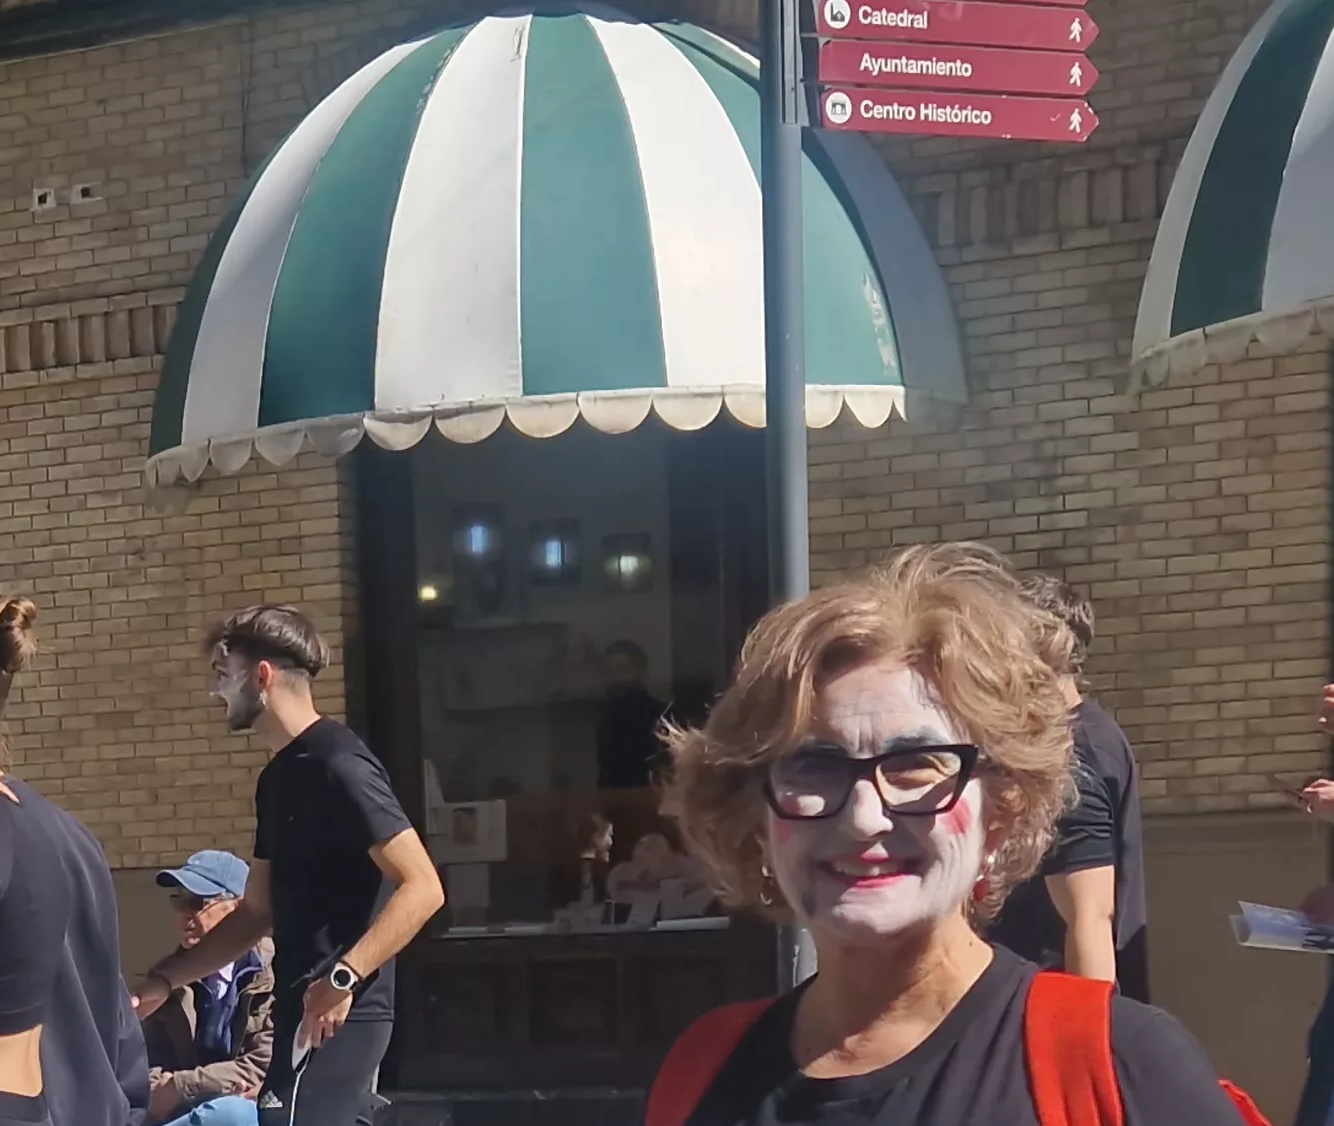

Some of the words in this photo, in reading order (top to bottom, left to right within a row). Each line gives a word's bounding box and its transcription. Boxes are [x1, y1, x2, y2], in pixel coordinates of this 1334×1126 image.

[857, 5, 928, 29] Catedral
[859, 52, 973, 78] Ayuntamiento
[859, 99, 917, 121] Centro
[919, 103, 992, 125] Histórico
